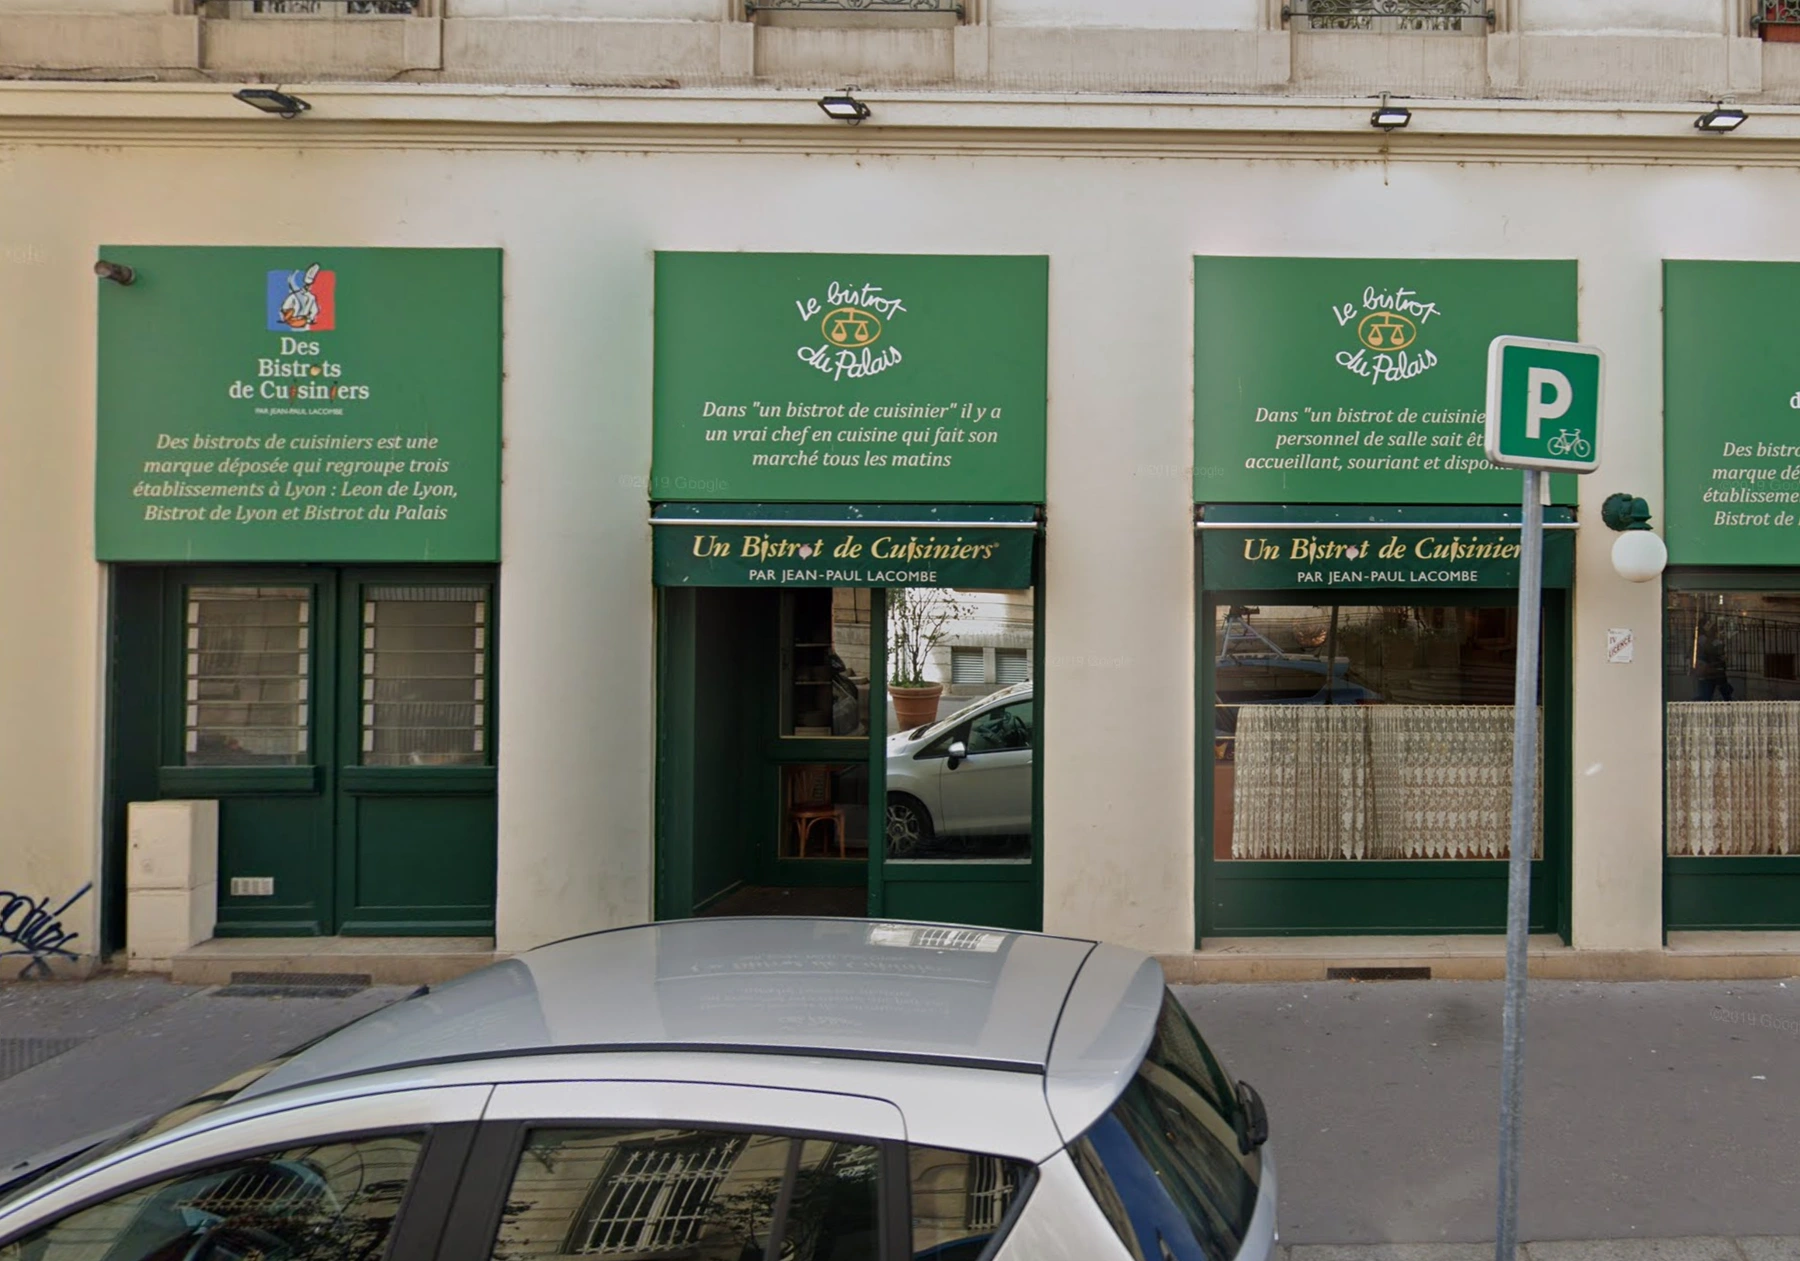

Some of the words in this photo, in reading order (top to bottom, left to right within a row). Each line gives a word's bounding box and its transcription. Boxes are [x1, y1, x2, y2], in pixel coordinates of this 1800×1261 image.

[796, 298, 821, 322] Le
[828, 281, 906, 320] bistrot
[1333, 302, 1357, 326] Le
[1361, 286, 1440, 326] bistrot
[281, 337, 319, 355] Des
[797, 345, 833, 373] du
[834, 346, 901, 381] Palais
[1336, 349, 1370, 378] du
[1372, 349, 1437, 384] Palais
[229, 381, 253, 398] de
[270, 407, 307, 416] JEAN-PAUL
[309, 408, 343, 416] LACOMBE
[703, 402, 746, 417] Dans
[753, 402, 781, 417] "un
[786, 402, 845, 417] bistrot
[849, 402, 869, 417] de
[874, 403, 957, 418] cuisinier"
[961, 403, 973, 420] il
[974, 406, 986, 422] y
[991, 408, 1001, 418] a
[1525, 367, 1573, 439] P
[1255, 408, 1298, 422] Dans
[1305, 407, 1331, 422] "un
[1337, 408, 1394, 422] bistrot
[1398, 408, 1417, 423] de
[1422, 408, 1486, 424] cuisinie
[157, 434, 188, 449] Des
[193, 434, 260, 449] bistrots
[265, 434, 286, 449] de
[290, 435, 373, 449] cuisiniers
[377, 436, 402, 449] est
[407, 438, 438, 449] une
[706, 430, 727, 441] un
[733, 427, 767, 441] vrai
[772, 426, 814, 445] chef
[812, 429, 832, 442] en
[837, 428, 897, 442] cuisine
[902, 428, 930, 446] qui
[932, 427, 965, 446] fait
[968, 432, 997, 442] son
[1275, 431, 1360, 449] personnel
[1364, 431, 1384, 446] de
[1388, 431, 1427, 446] salle
[1431, 433, 1463, 446] sait
[1467, 428, 1487, 449] êt
[753, 450, 818, 465] marché
[823, 453, 860, 466] tous
[864, 451, 887, 466] les
[892, 452, 951, 466] matins
[1723, 442, 1752, 456] Des
[144, 461, 213, 476] marque
[218, 458, 289, 476] déposée
[293, 459, 322, 477] qui
[326, 462, 405, 477] regroupe
[410, 458, 449, 472] trois
[1244, 454, 1342, 471] accueillant,
[1347, 455, 1420, 469] souriant
[1424, 457, 1440, 469] et
[1444, 454, 1510, 474] dispo
[1712, 469, 1776, 483] marque
[1781, 465, 1800, 480] dé
[133, 481, 264, 497] établissements
[269, 481, 279, 496] à
[285, 482, 326, 500] Lyon
[341, 482, 382, 496] Leon
[387, 481, 408, 496] de
[413, 481, 457, 500] Lyon,
[1703, 488, 1800, 502] établisseme
[145, 505, 206, 520] Bistrot
[209, 505, 231, 520] de
[236, 505, 277, 524] Lyon
[282, 507, 300, 520] et
[304, 505, 364, 520] Bistrot
[368, 505, 389, 520] du
[395, 505, 447, 522] Palais
[1714, 511, 1770, 525] Bistrot
[1774, 511, 1794, 525] de
[693, 536, 730, 556] Un
[741, 534, 823, 562] Bistrot
[834, 536, 862, 558] de
[1244, 539, 1279, 560] Un
[1290, 536, 1369, 564] Bistrot
[1379, 536, 1406, 558] de
[1415, 536, 1521, 562] Cuisinier
[750, 570, 775, 580] PAR
[781, 570, 862, 583] JEAN-PAUL
[868, 571, 936, 582] LACOMBE
[1298, 572, 1323, 582] PAR
[1328, 571, 1405, 584] JEAN-PAUL
[1411, 571, 1477, 581] LACOMBE
